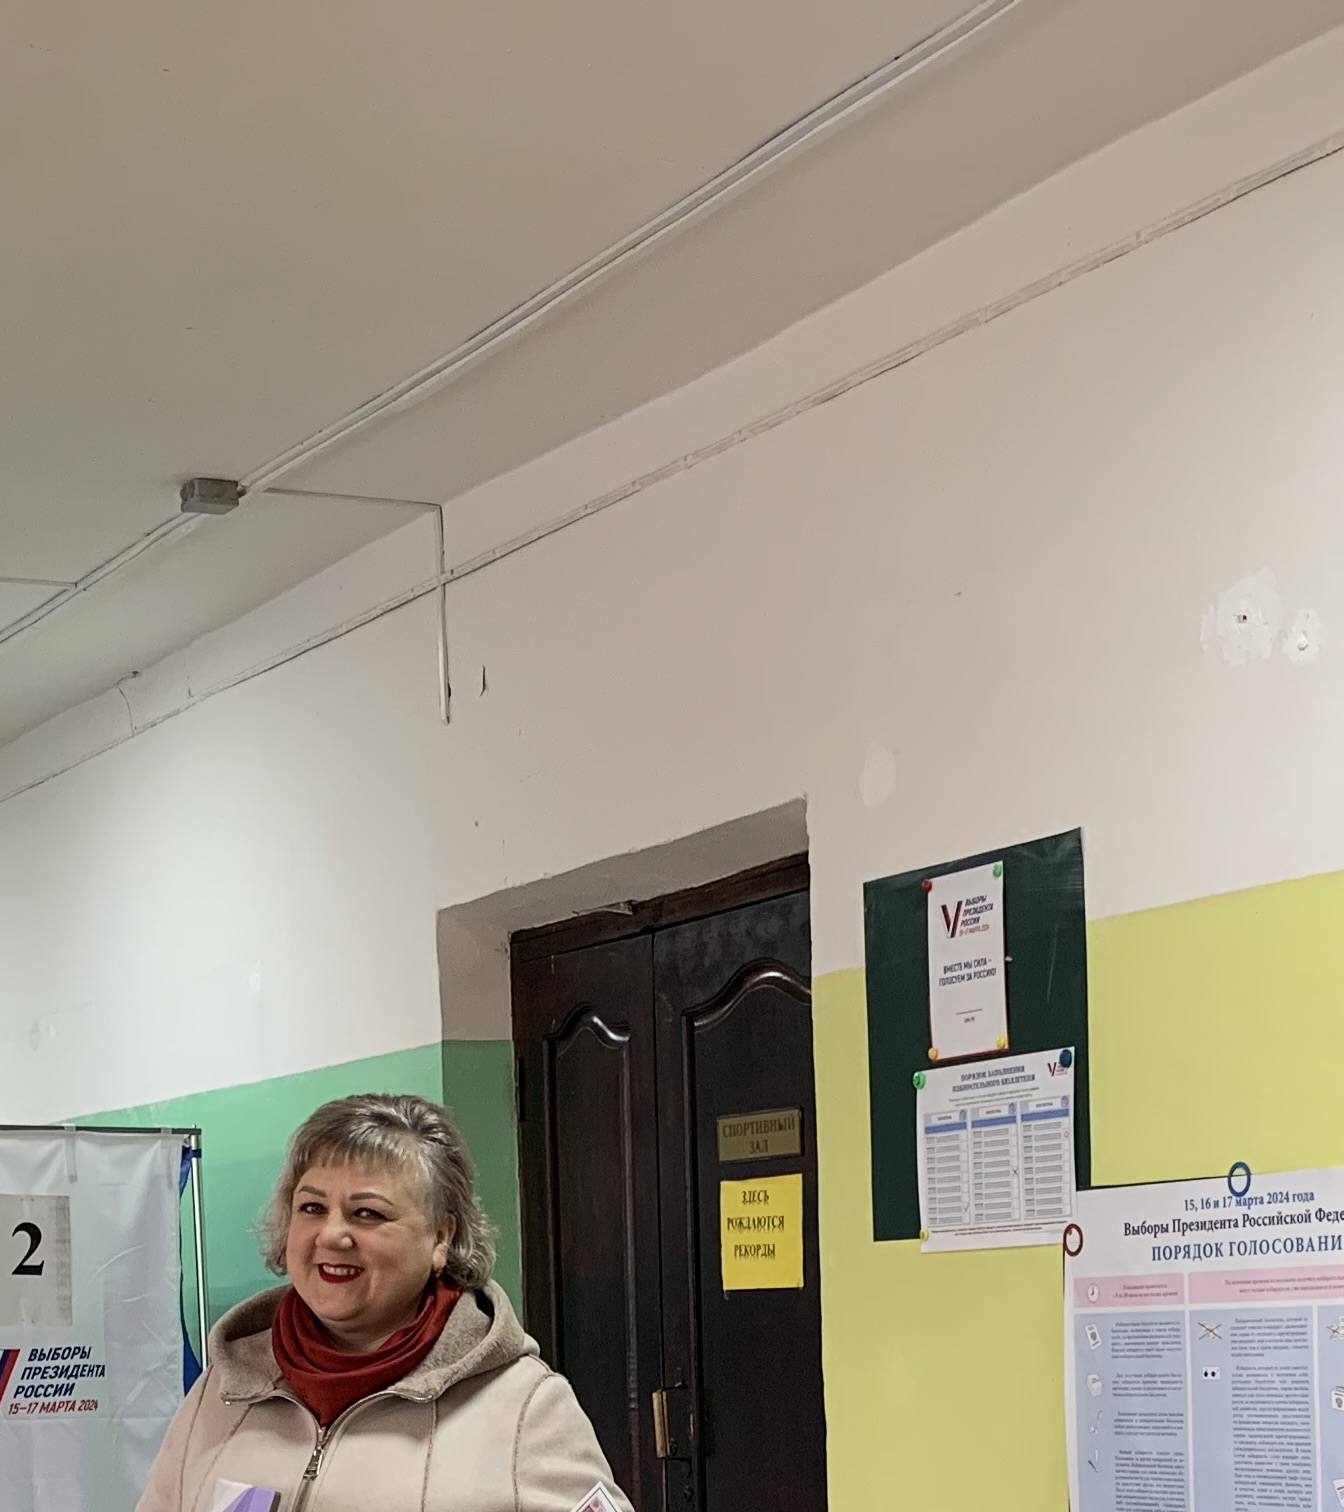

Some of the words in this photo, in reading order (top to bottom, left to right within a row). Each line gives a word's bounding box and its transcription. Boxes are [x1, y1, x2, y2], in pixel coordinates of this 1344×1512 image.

[943, 961, 963, 975] ВМЕСТЕ
[963, 960, 973, 972] МЫ
[973, 957, 987, 969] СИЛА
[938, 974, 965, 987] ГОЛОСУЕМ
[966, 973, 973, 982] ЗА
[722, 1114, 796, 1139] СПОРТИВНЫЙ
[749, 1139, 769, 1154] ЗАЛ
[741, 1189, 770, 1204] ЗДЕСЬ
[1184, 1199, 1198, 1212] 15,
[1200, 1197, 1212, 1210] 16
[1213, 1199, 1220, 1208] и
[1222, 1196, 1233, 1208] 17
[1235, 1196, 1265, 1210] марта
[1266, 1190, 1290, 1204] 2024
[1292, 1191, 1315, 1205] года
[727, 1215, 785, 1231] РОЖДАЮТСЯ
[1123, 1221, 1169, 1238] Выборы
[1172, 1218, 1239, 1237] Президента
[1242, 1210, 1312, 1229] Российской
[11, 1222, 44, 1276] 2
[734, 1243, 776, 1258] РЕКОРДЫ
[1151, 1241, 1225, 1262] ПОРЯДОК
[27, 1345, 92, 1362] ВЫБОРЫ
[20, 1364, 106, 1381] ПРЕЗИДЕНТА
[13, 1382, 76, 1399] РОССИИ
[39, 1401, 76, 1414] МАРТА
[76, 1399, 99, 1412] 2024
